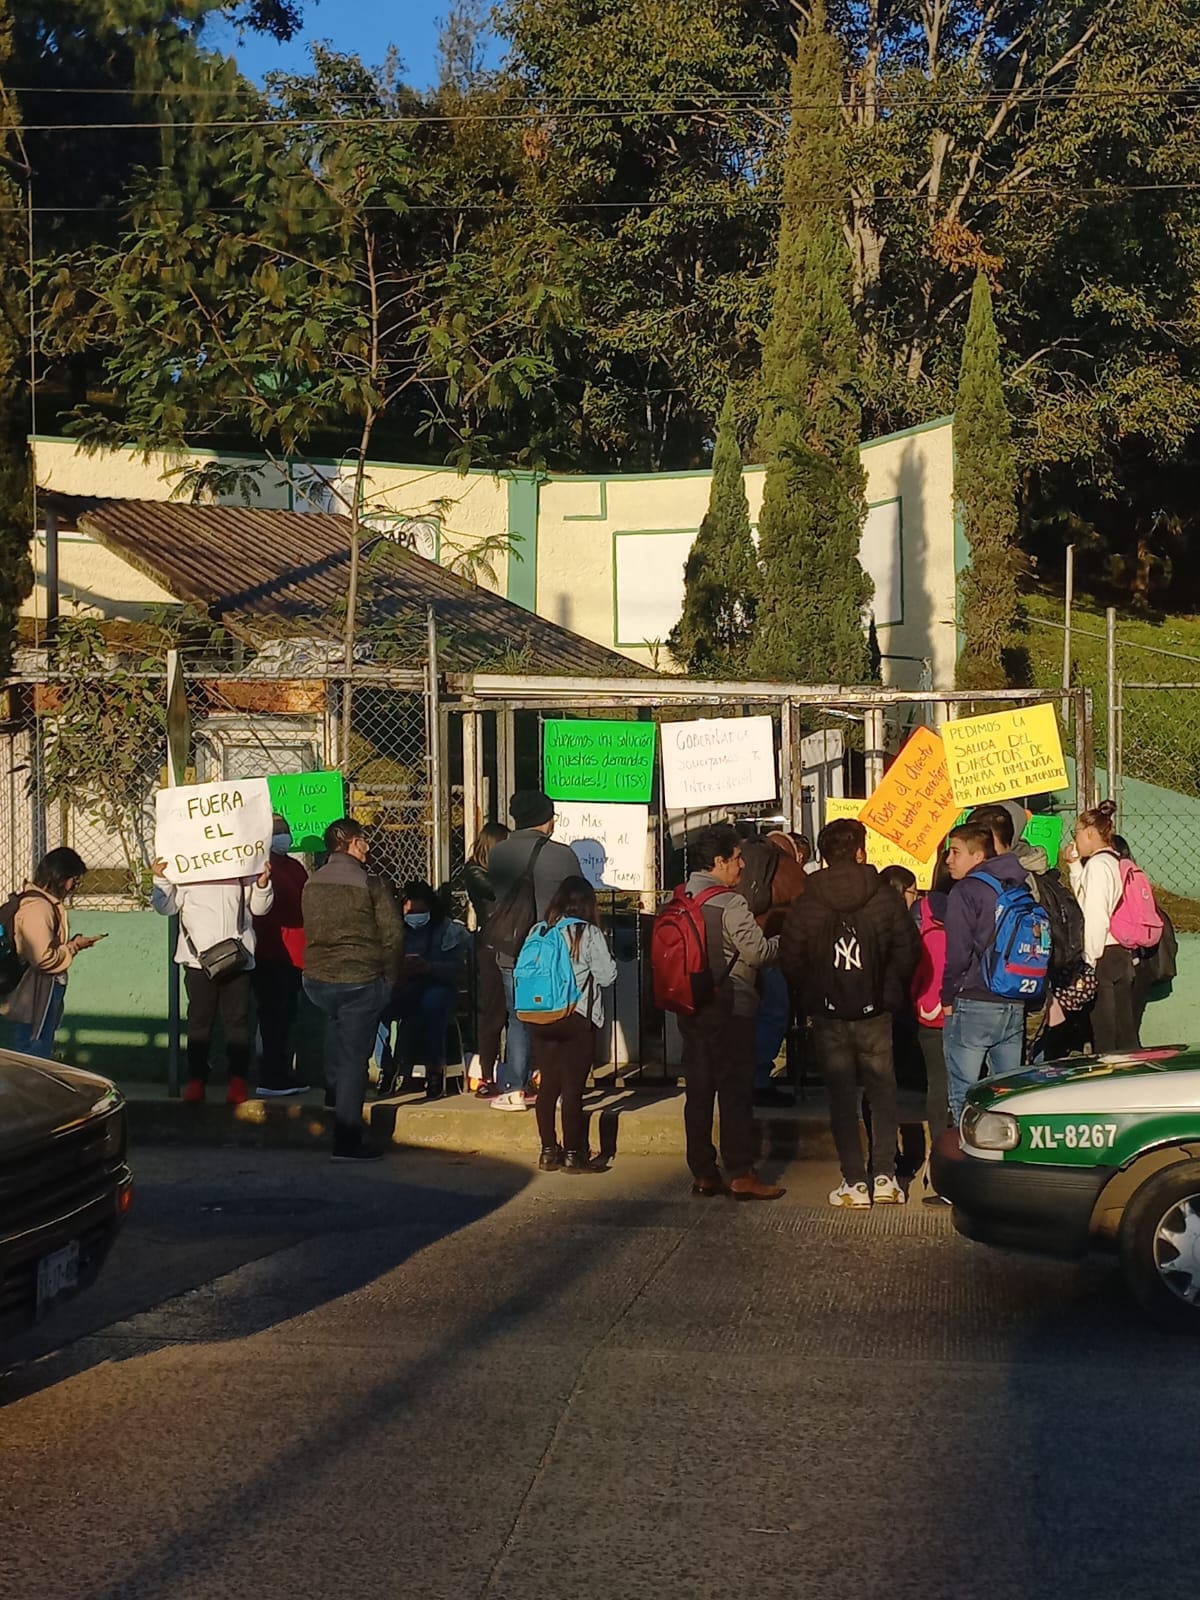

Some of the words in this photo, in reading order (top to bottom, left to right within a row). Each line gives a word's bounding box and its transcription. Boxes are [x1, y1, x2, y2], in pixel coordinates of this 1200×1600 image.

[949, 720, 1001, 740] PEDIMOS
[954, 739, 997, 758] SALIDA
[1007, 732, 1033, 748] DEL
[956, 747, 1023, 775] DIRECTOR
[299, 783, 328, 798] ACOSO
[894, 779, 911, 796] el
[953, 769, 996, 790] MANERA
[955, 789, 972, 802] POR
[975, 782, 1006, 798] ABUSO
[1010, 778, 1022, 790] DE
[187, 790, 245, 820] FUERA
[203, 823, 235, 840] EL
[175, 840, 265, 874] DIRECTOR
[1019, 978, 1038, 994] 23
[1029, 1124, 1117, 1149] XL-8267
